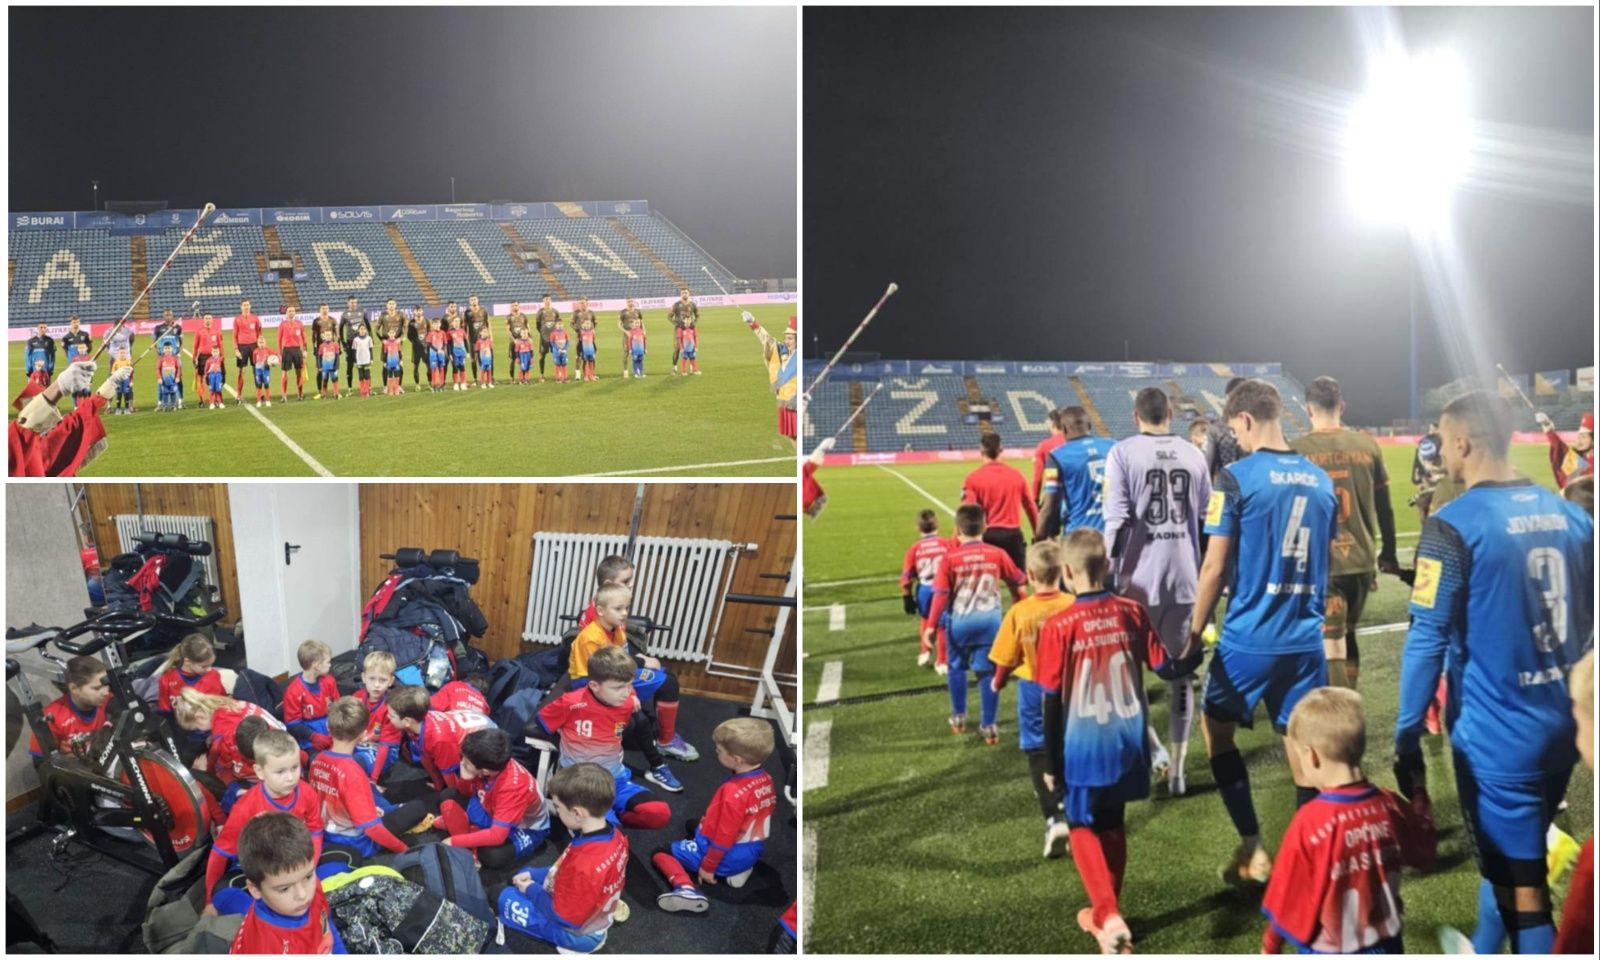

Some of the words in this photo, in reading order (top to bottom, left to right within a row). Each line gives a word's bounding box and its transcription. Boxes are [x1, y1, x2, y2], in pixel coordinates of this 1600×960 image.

[31, 217, 64, 225] BURAI
[1281, 495, 1311, 572] 4
[1526, 546, 1568, 653] 3
[1077, 650, 1141, 725] 40
[574, 719, 593, 737] 19
[128, 756, 153, 804] SCHWINN
